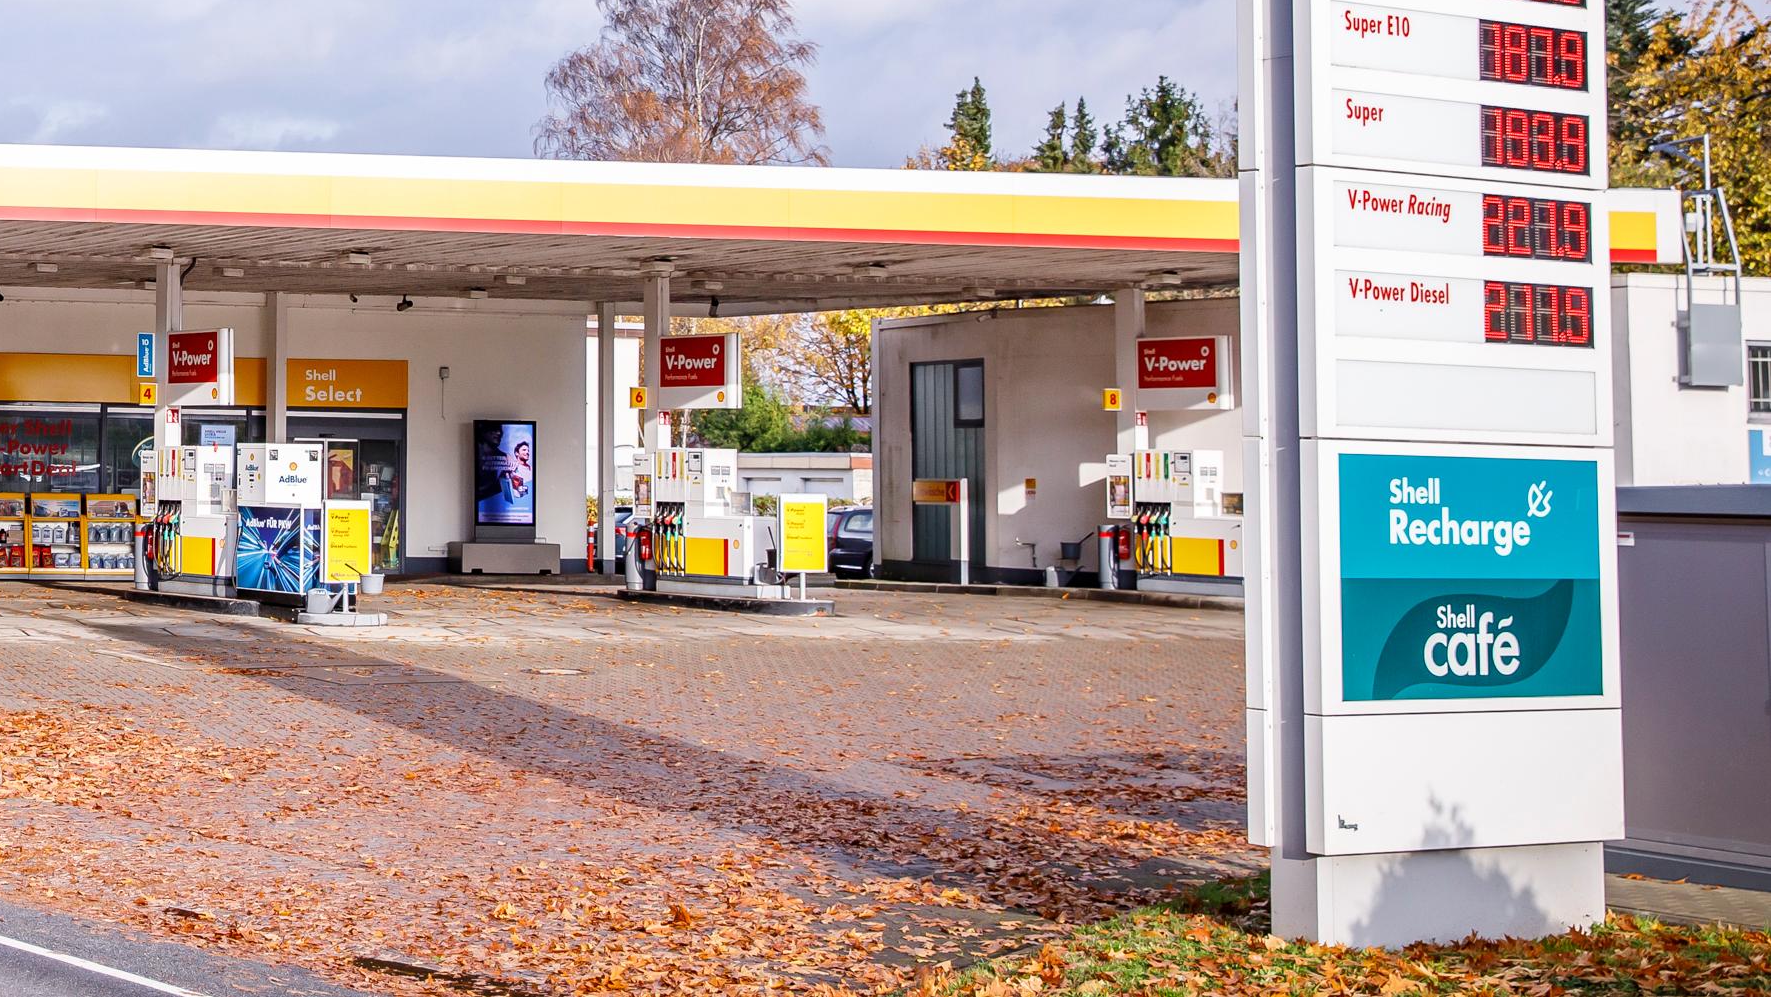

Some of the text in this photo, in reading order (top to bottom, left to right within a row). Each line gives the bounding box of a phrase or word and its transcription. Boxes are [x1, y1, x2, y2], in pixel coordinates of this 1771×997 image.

[1345, 10, 1382, 39] Super
[1387, 15, 1410, 37] E10
[1346, 98, 1384, 126] Super
[1347, 188, 1404, 214] V-Power
[1407, 194, 1451, 223] Racing
[1349, 277, 1405, 302] V-Power
[1410, 282, 1449, 304] Diesel
[172, 350, 212, 366] V-Power
[665, 354, 717, 370] V-Power
[1144, 356, 1207, 372] V-Power
[305, 369, 336, 381] Shell
[144, 388, 151, 399] 4
[305, 385, 362, 402] Select
[635, 391, 643, 403] 6
[1110, 393, 1117, 405] 8
[23, 419, 73, 436] Shell
[31, 460, 76, 476] Deal
[279, 474, 307, 484] AdBlue
[1389, 476, 1441, 505] Shell
[266, 517, 277, 529] FÜR
[278, 519, 292, 530] PKW
[1389, 506, 1531, 557] Recharge
[1436, 604, 1476, 629] Shell
[1423, 611, 1521, 677] café
